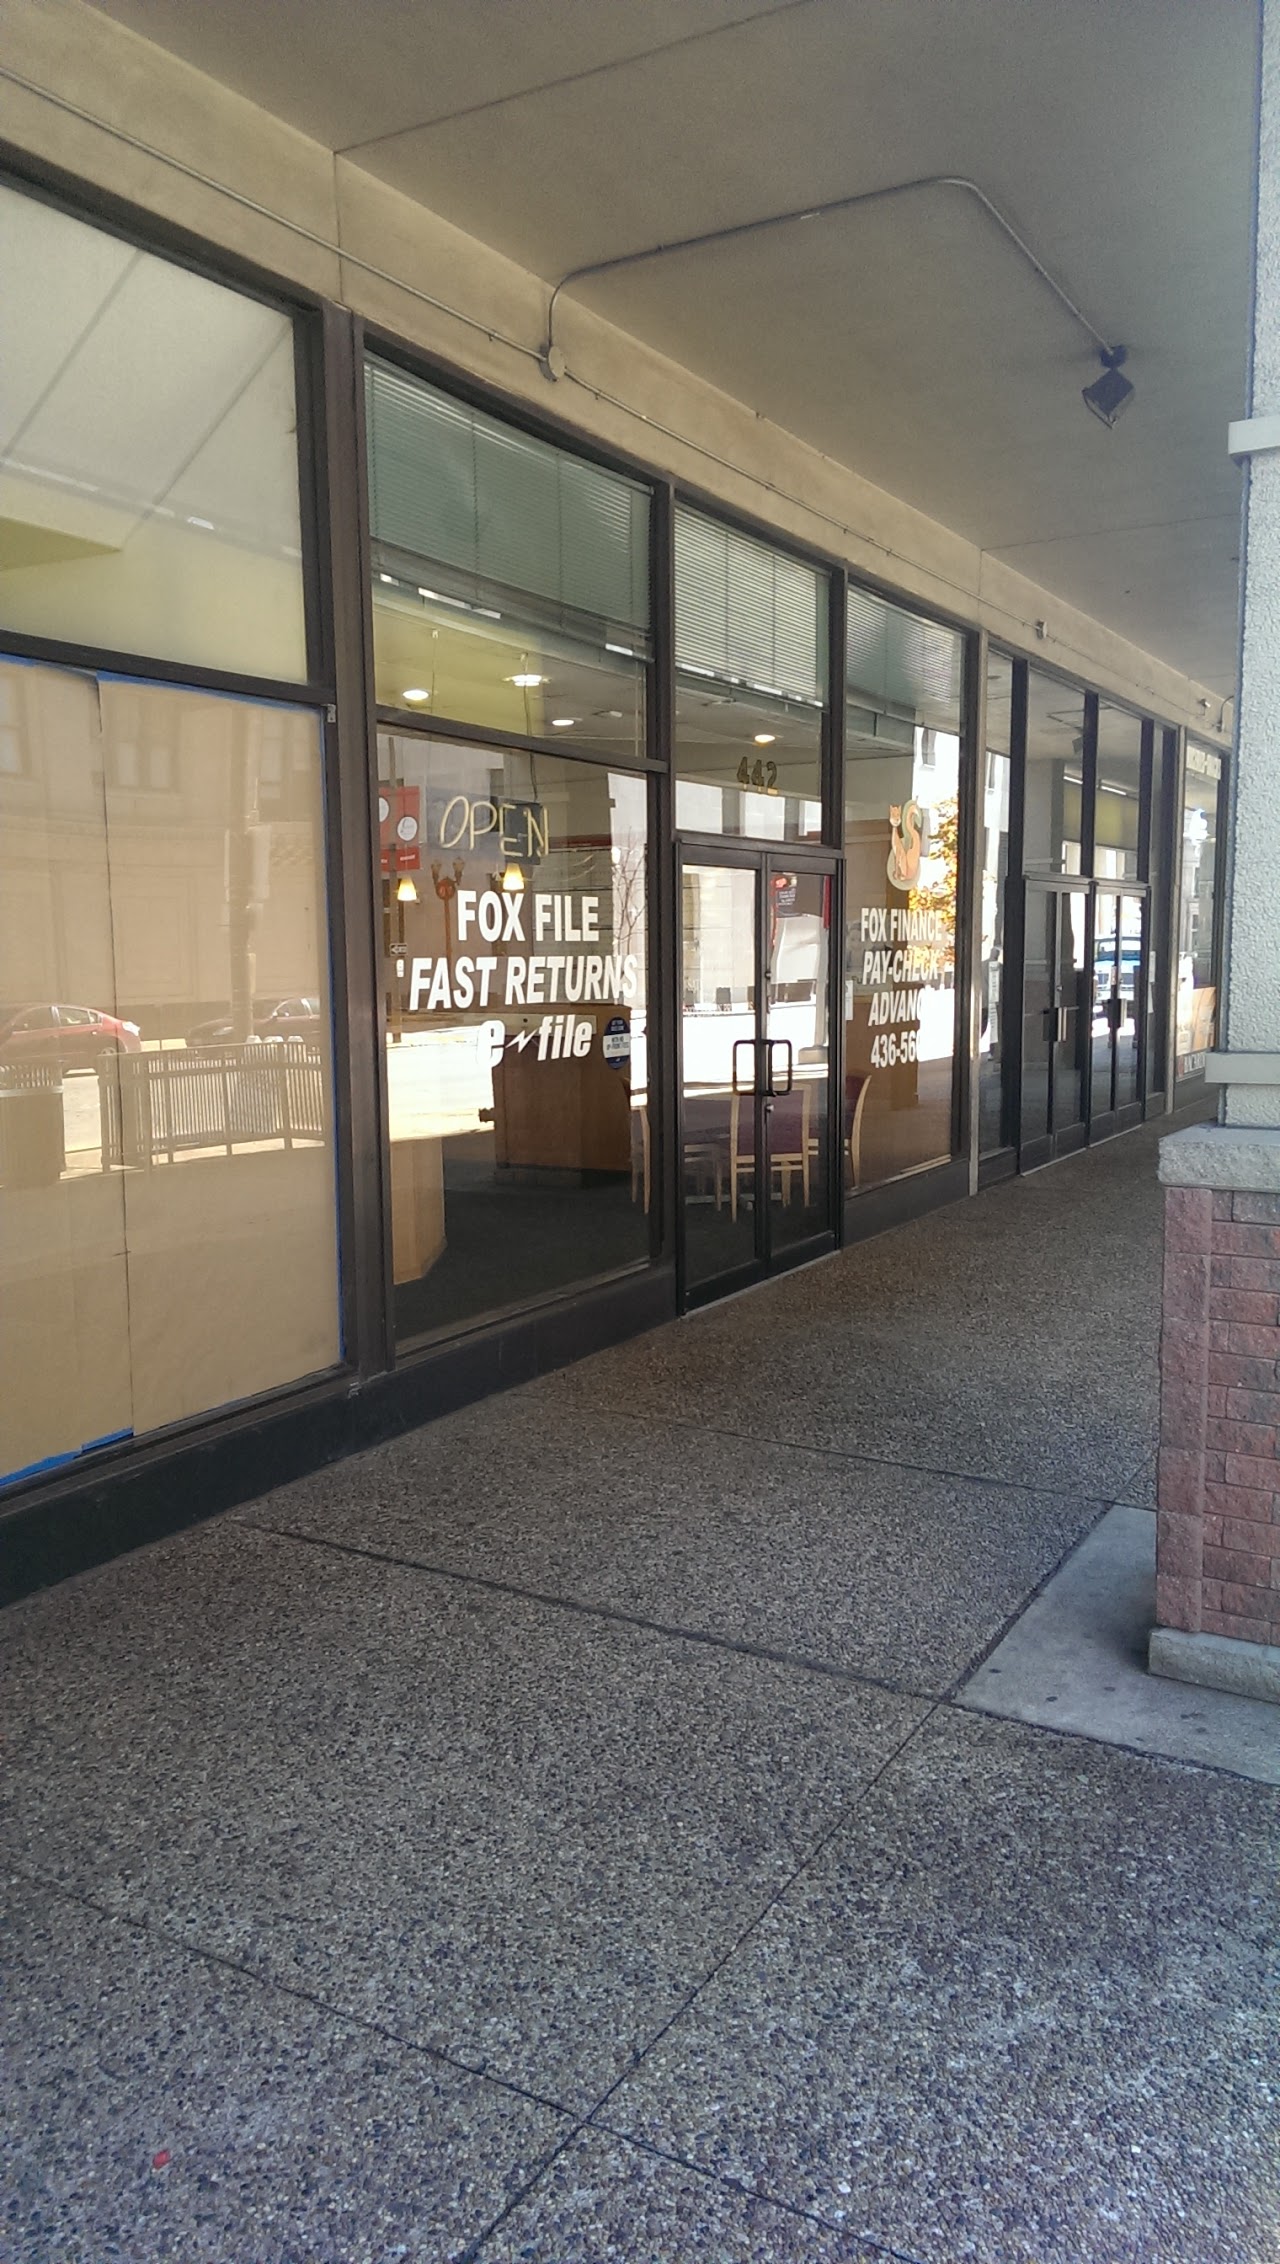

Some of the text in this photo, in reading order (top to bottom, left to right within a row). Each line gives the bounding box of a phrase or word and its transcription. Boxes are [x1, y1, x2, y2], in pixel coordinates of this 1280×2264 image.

[737, 756, 778, 795] 442
[440, 795, 549, 858] OPEN
[457, 890, 599, 942] FOX FILE
[860, 908, 942, 942] FOX FINANCE
[409, 955, 638, 1011] FAST RETURNS
[862, 948, 939, 985] PAY-CHECK
